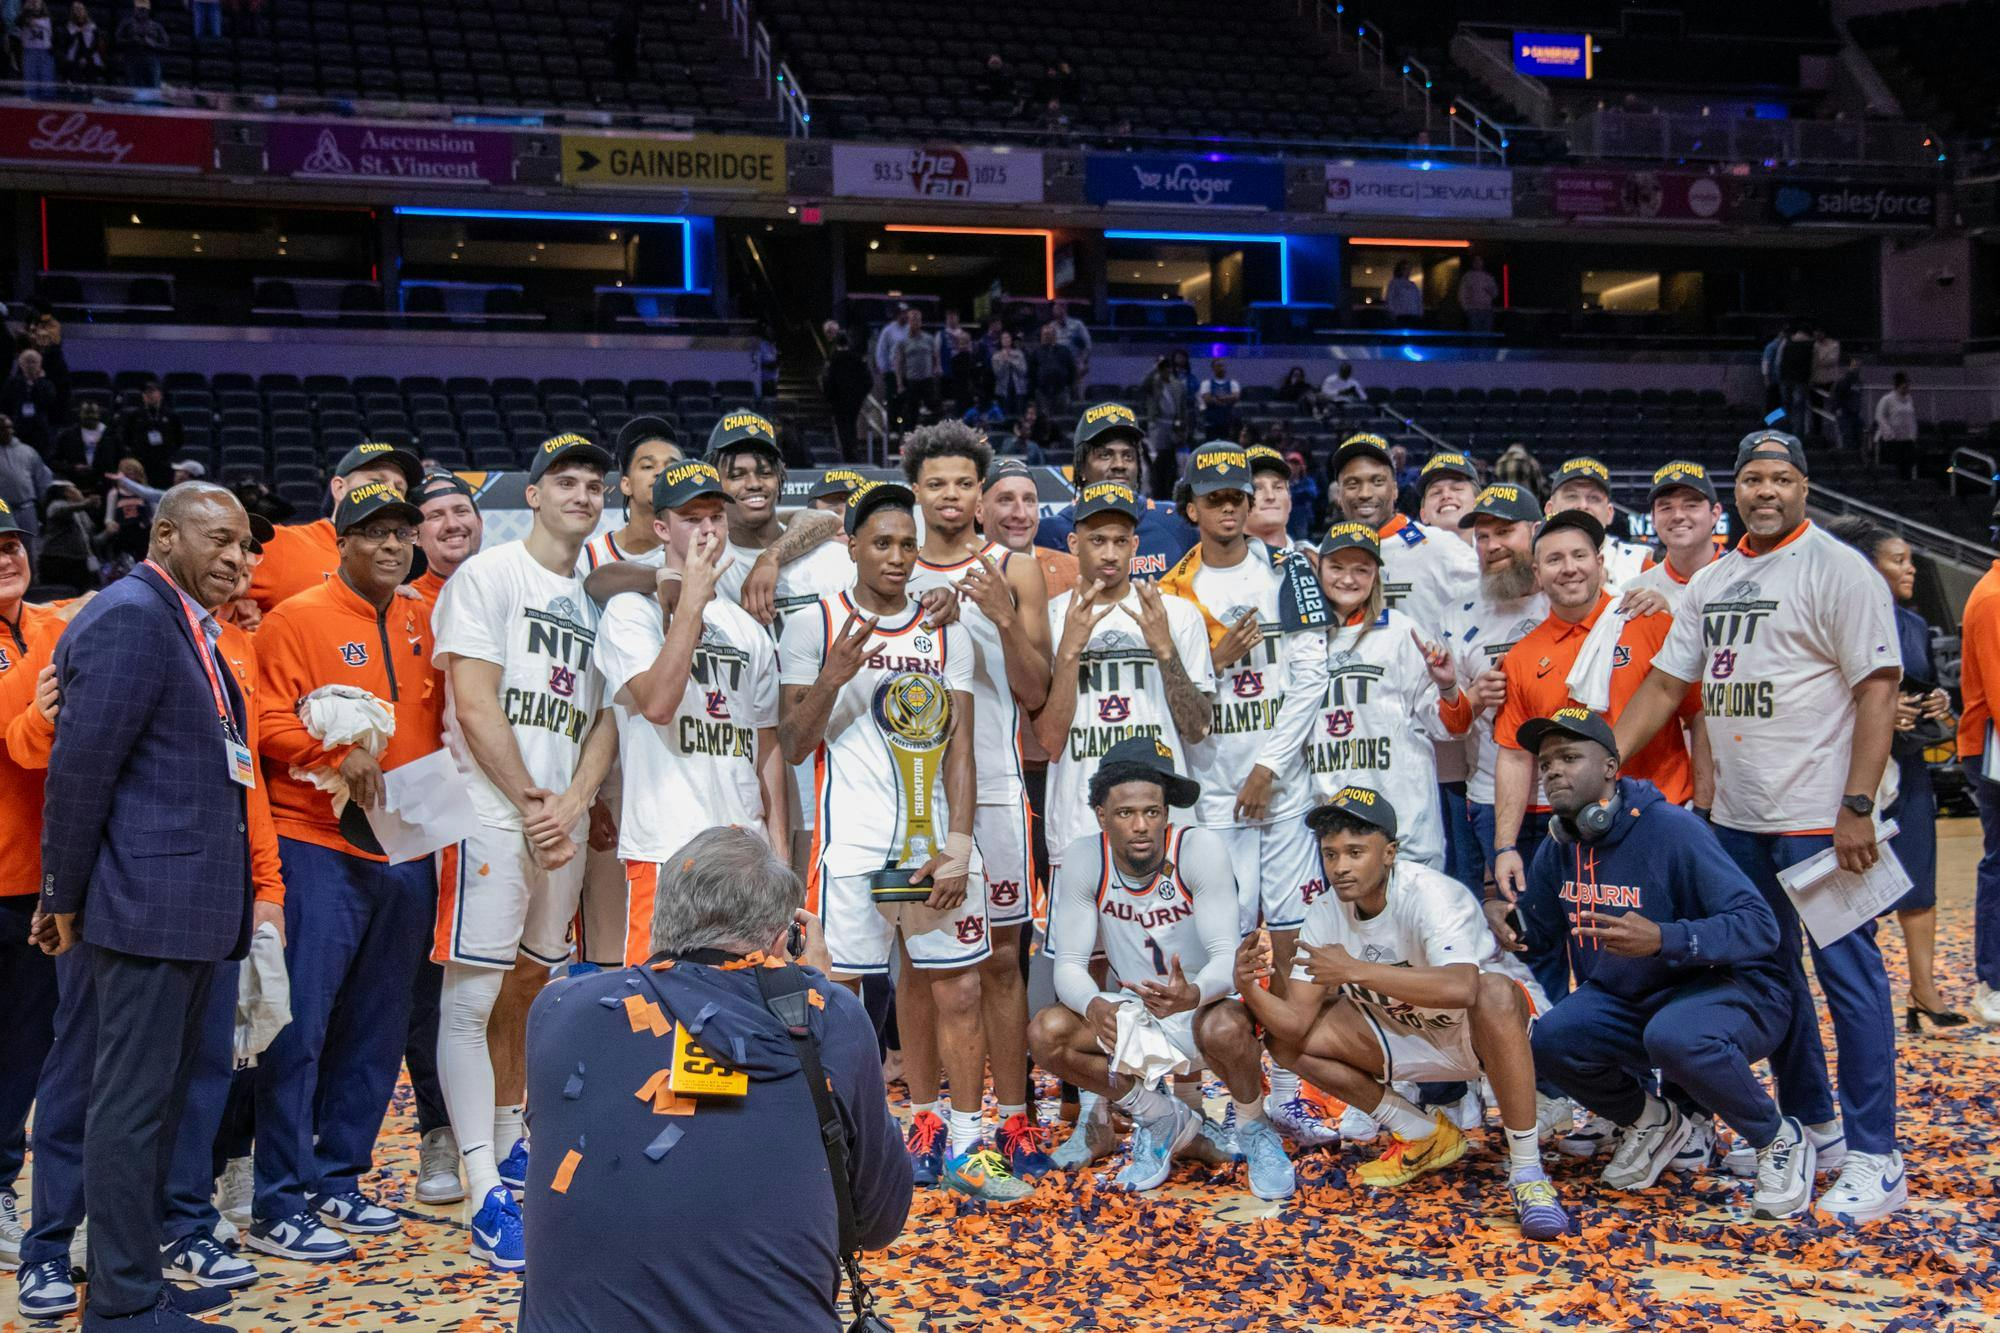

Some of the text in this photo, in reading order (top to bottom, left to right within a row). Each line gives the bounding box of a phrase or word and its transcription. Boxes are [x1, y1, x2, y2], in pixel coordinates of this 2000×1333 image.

[29, 112, 134, 165] Lilly
[361, 131, 475, 153] Ascension
[360, 154, 479, 179] St. Vincent
[609, 150, 774, 181] GAINBRIDGE
[1165, 163, 1233, 205] Kroger
[1354, 183, 1414, 199] KRIEG
[1818, 190, 1932, 220] salesforce
[1086, 405, 1135, 423] CHAMPIONS
[1196, 452, 1246, 470] CHAMPIONS
[1562, 460, 1610, 481] CHAMPIONS
[1654, 463, 1704, 485] CHAMPIONS
[1083, 484, 1134, 504] CHAMPIONS
[1299, 575, 1327, 623] 2026
[1703, 612, 1770, 647] NIT
[527, 621, 594, 673] NIT
[1079, 660, 1154, 694] NIT
